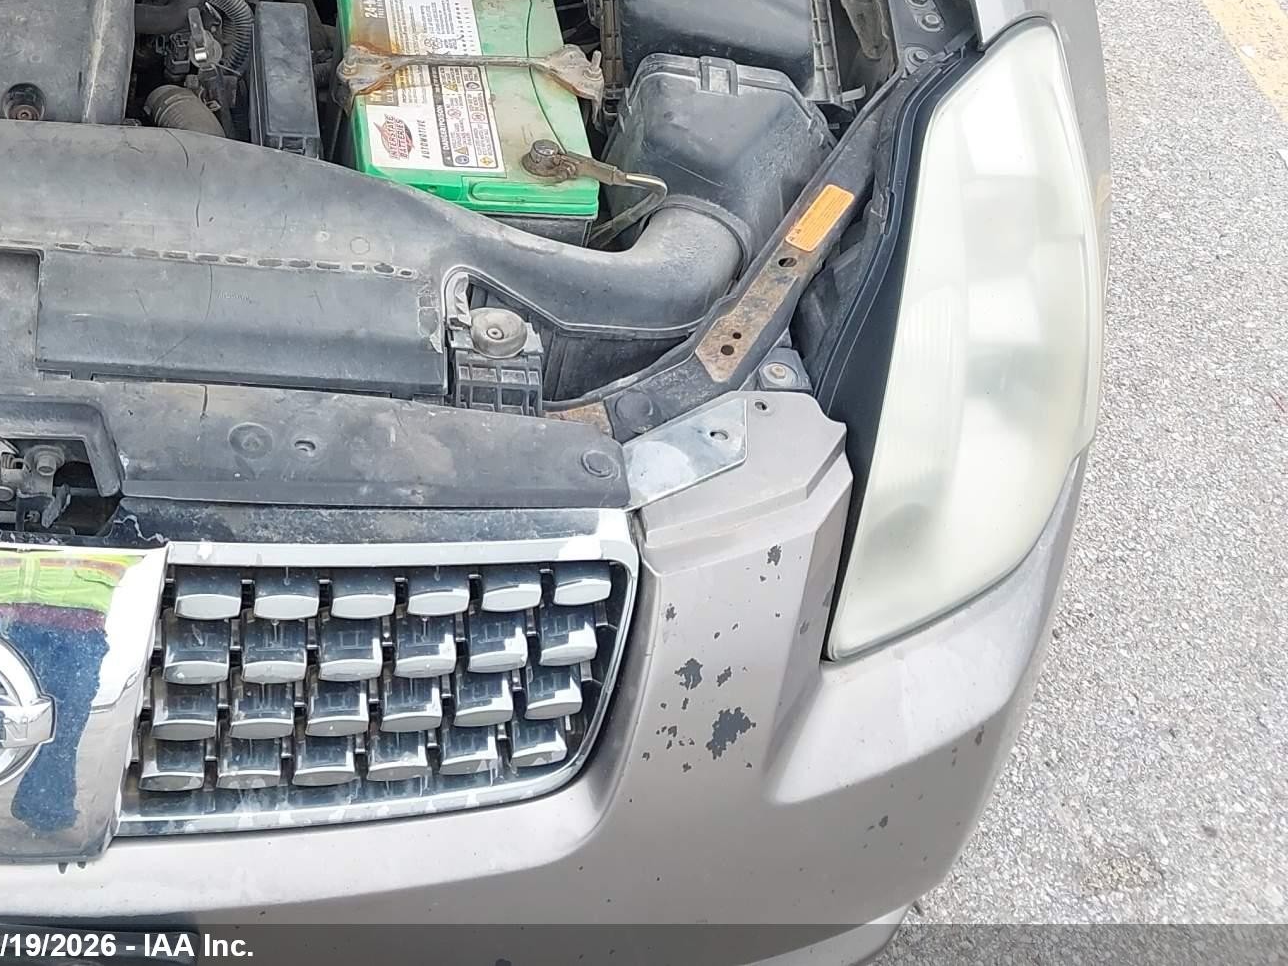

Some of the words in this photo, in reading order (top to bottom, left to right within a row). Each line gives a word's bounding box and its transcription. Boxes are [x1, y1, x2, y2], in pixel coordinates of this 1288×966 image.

[385, 114, 399, 159] INTERSTATE
[395, 118, 409, 159] BATTERIES
[416, 119, 430, 159] AUTOMOTIVE
